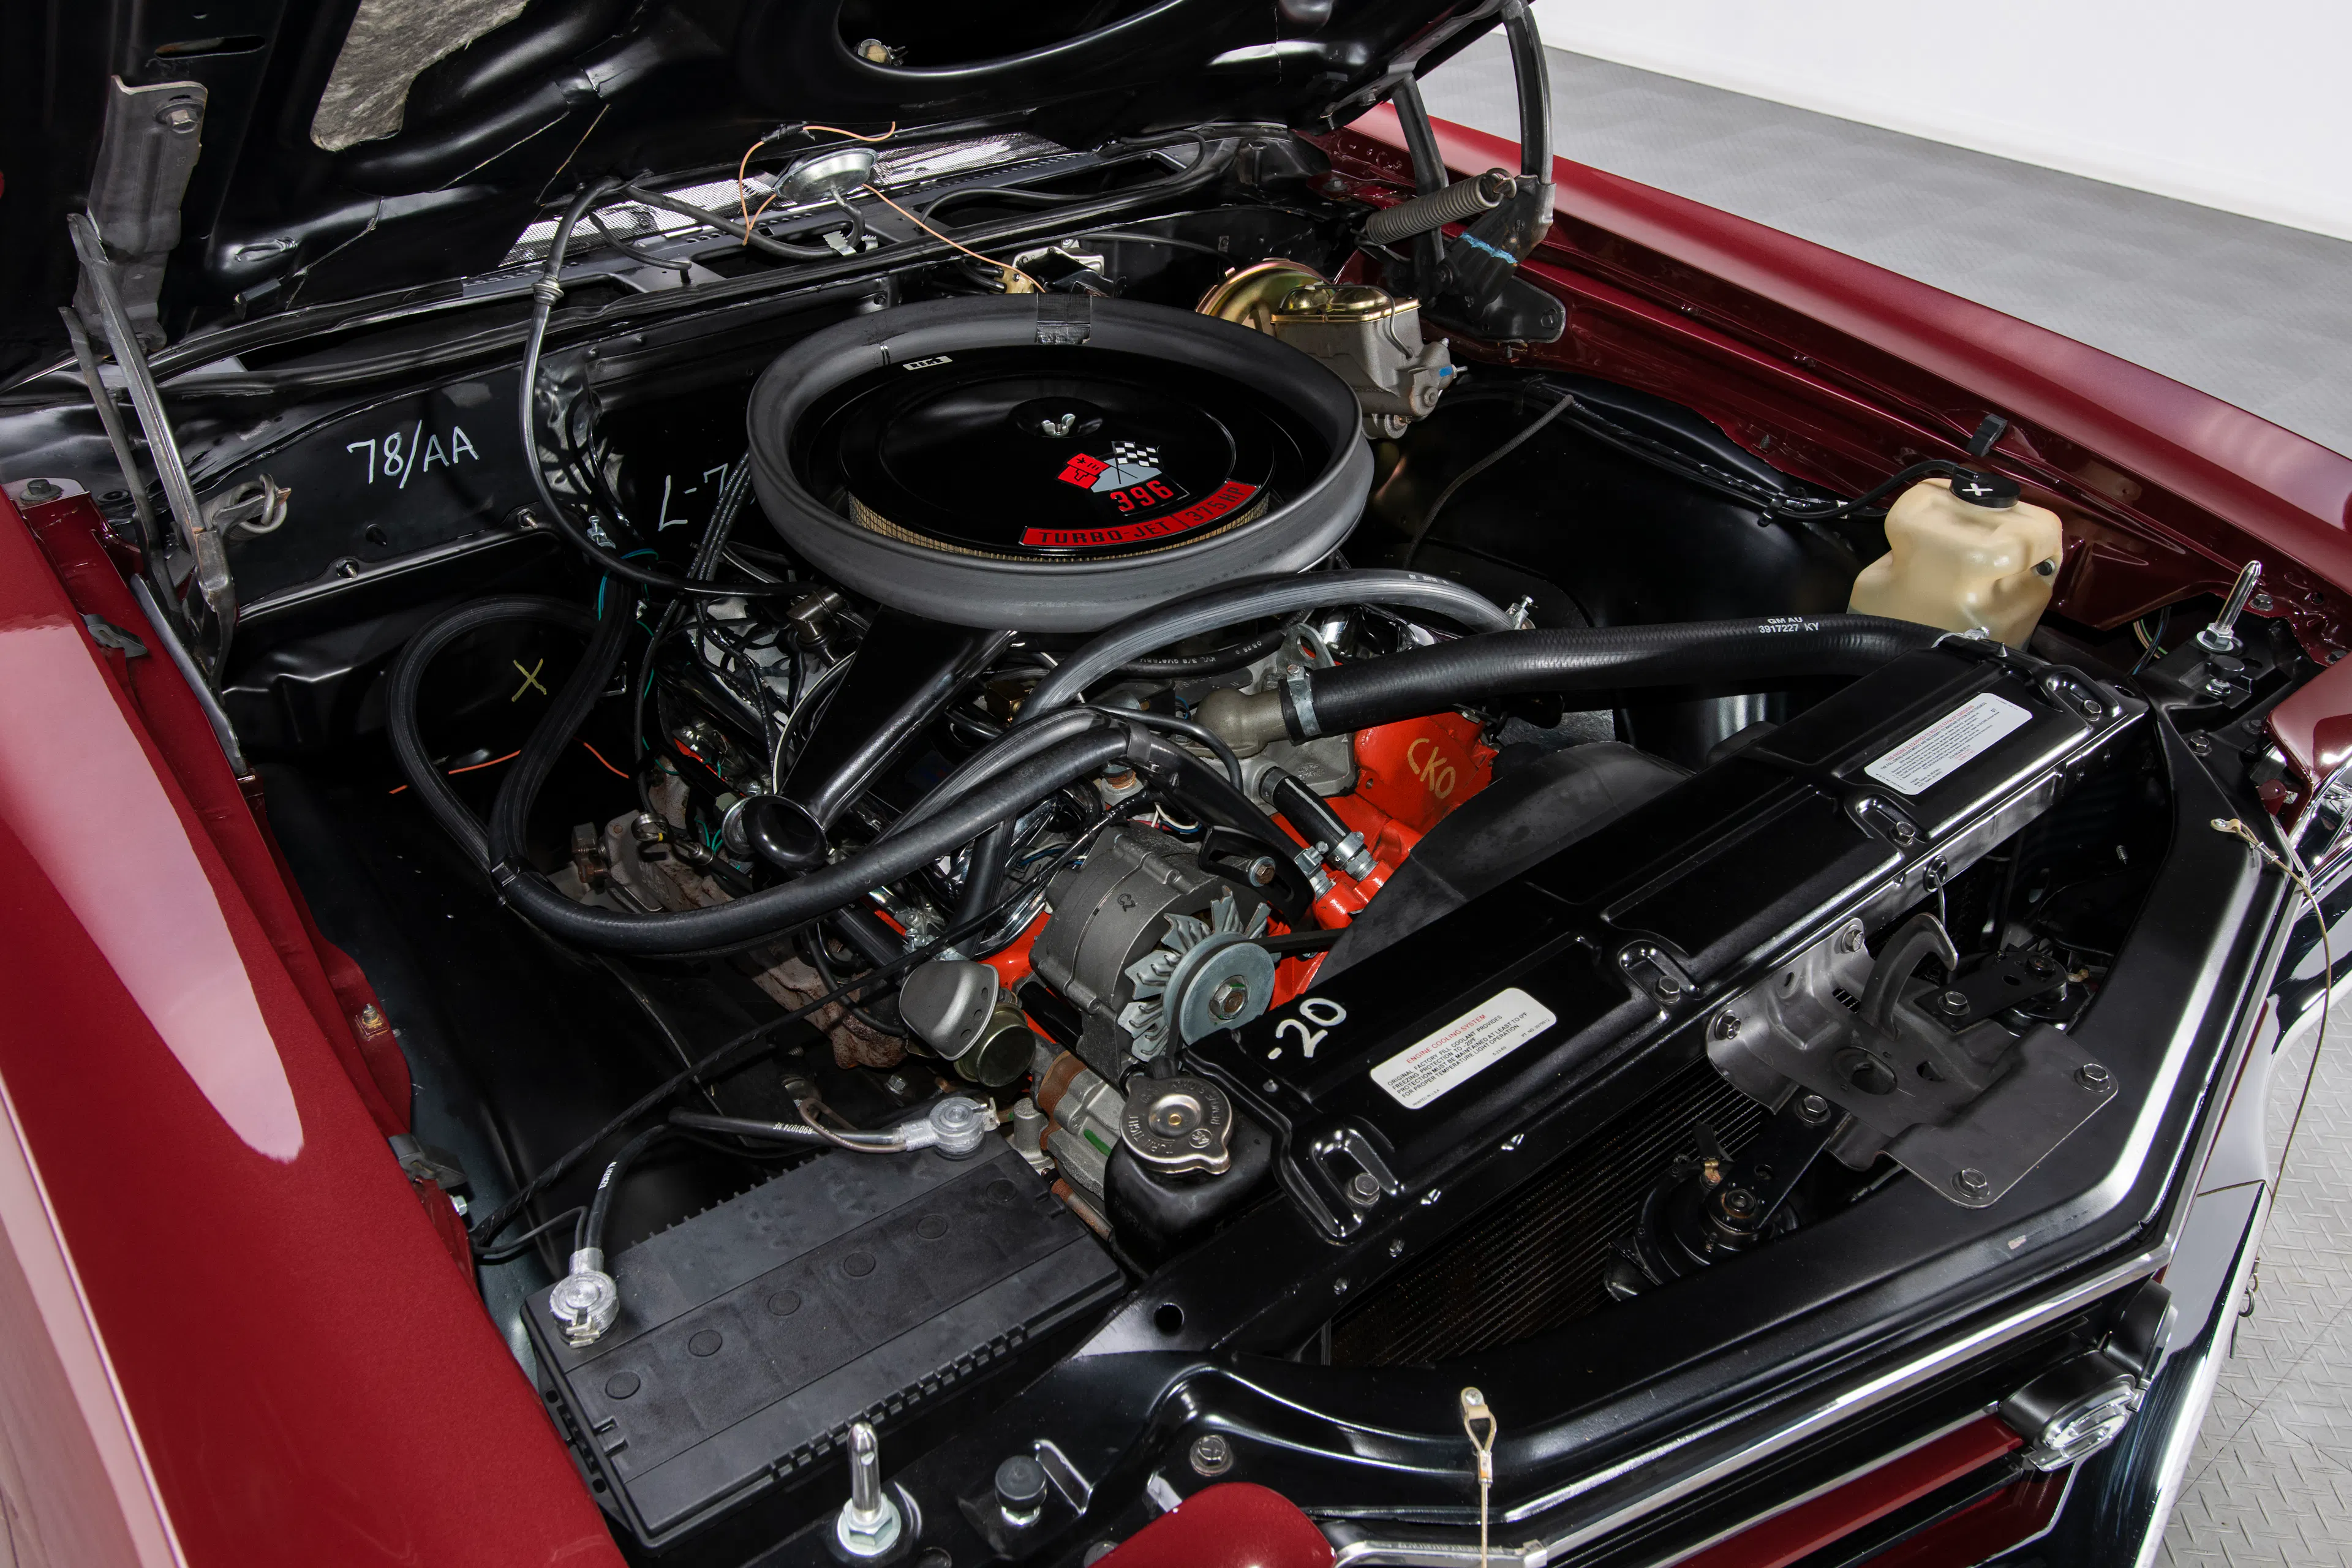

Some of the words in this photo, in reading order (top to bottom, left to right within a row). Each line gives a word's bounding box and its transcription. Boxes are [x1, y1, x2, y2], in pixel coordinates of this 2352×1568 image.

[909, 357, 944, 368] REAR
[347, 420, 480, 489] 78/AA
[725, 470, 738, 491] PACKARD
[731, 467, 747, 496] SUPPRESSION
[1110, 480, 1174, 512] 396
[702, 514, 715, 545] SUPPRESSION
[725, 504, 737, 525] PACKARD
[1039, 522, 1172, 544] TURBO-JET
[1185, 502, 1227, 521] 375
[1221, 487, 1246, 503] HP
[1758, 624, 1798, 633] 3917227
[1804, 622, 1819, 631] KY
[749, 668, 761, 693] SUPPRESSION
[1891, 747, 1907, 757] ENGINE
[1907, 735, 1927, 747] EQUIPPED
[1928, 724, 1945, 734] REDUCE
[1941, 715, 1959, 726] EXHAUST
[1407, 737, 1456, 799] CKO
[1386, 1068, 1414, 1087] ORIGINAL
[1412, 1053, 1439, 1071] FACTORY
[1438, 1046, 1452, 1055] FILL
[1450, 1030, 1477, 1048] COOLANT
[1475, 1014, 1503, 1032] PROVIDES
[1396, 1070, 1433, 1095] PROTECTION
[1431, 1061, 1448, 1073] MUST
[1454, 1036, 1489, 1059] MAINTAINED
[1494, 1022, 1513, 1035] LEAST
[1405, 1047, 1432, 1064] ENGINE
[1430, 1028, 1462, 1049] COOLING
[1460, 1014, 1487, 1031] SYSTEM
[1391, 1071, 1420, 1090] FREEZING
[1419, 1051, 1454, 1074] PROTECTION
[1401, 1088, 1415, 1098] FOR
[1412, 1075, 1437, 1091] PROPER
[1434, 1052, 1474, 1077] TEMPERATURE
[1472, 1042, 1491, 1054] LIGHT
